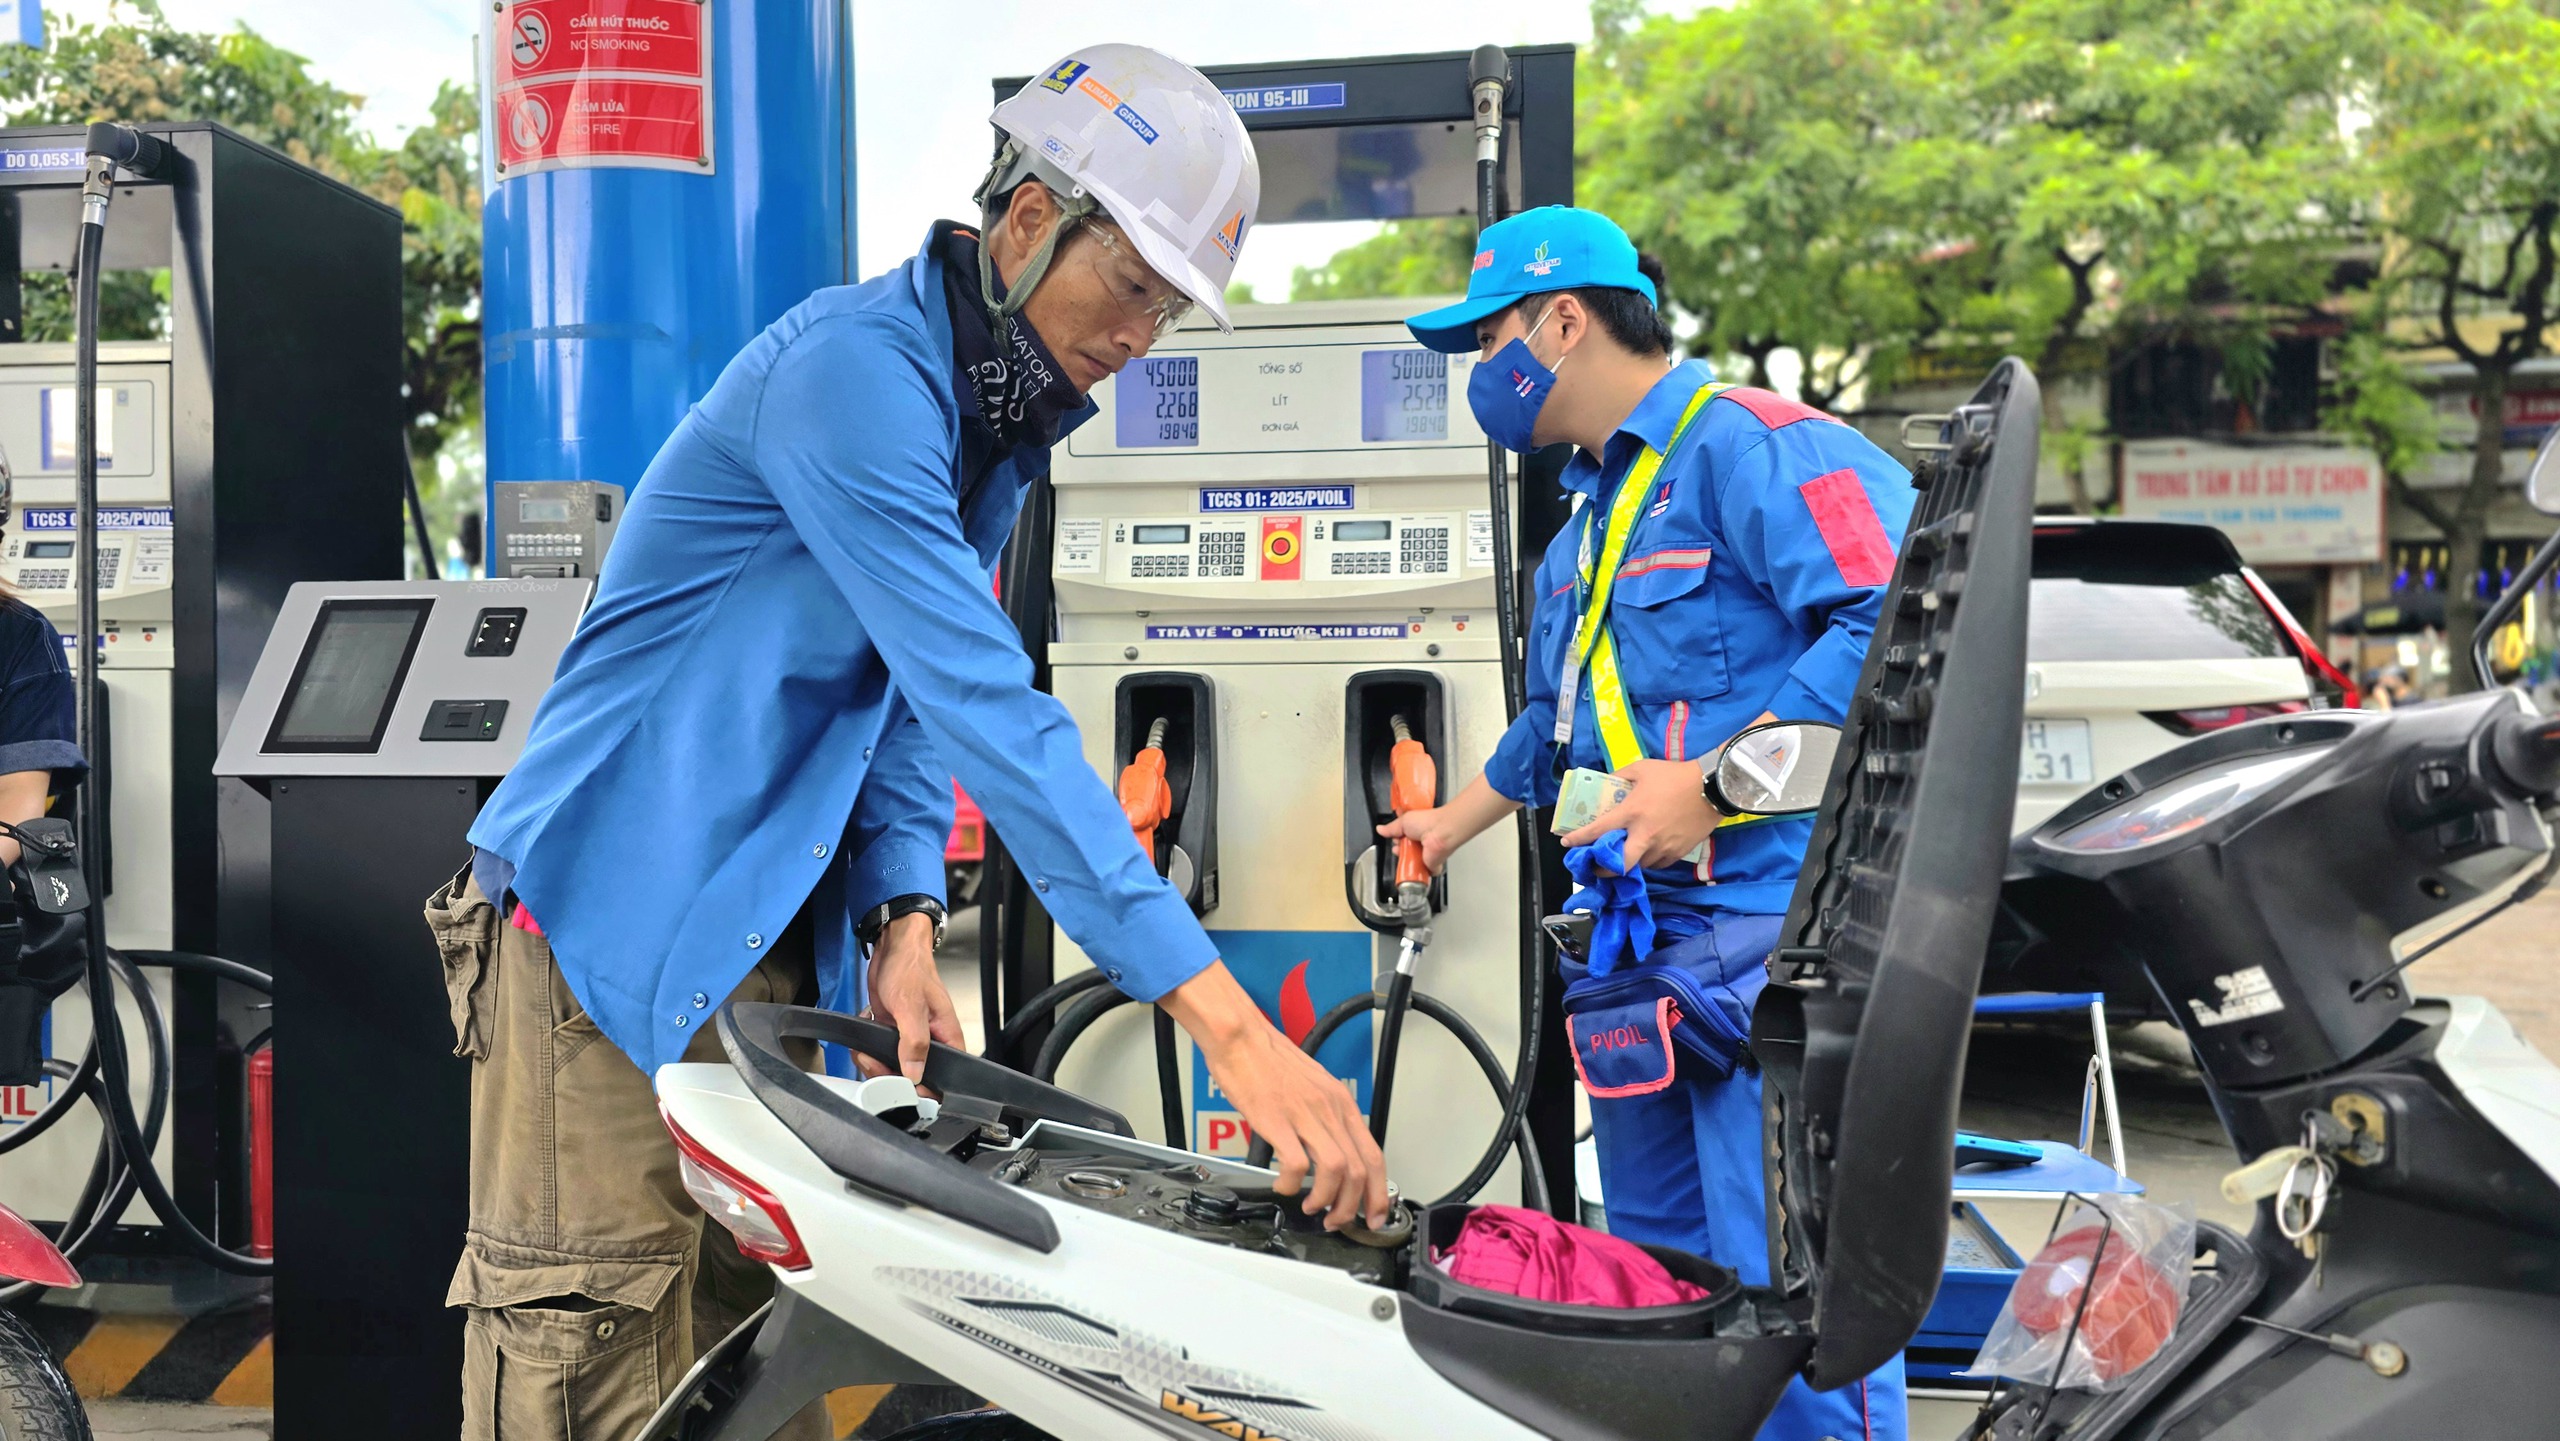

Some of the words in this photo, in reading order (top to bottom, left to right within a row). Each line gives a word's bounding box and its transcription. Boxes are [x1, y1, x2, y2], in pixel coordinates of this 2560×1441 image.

[570, 13, 597, 28] CẤM
[601, 13, 623, 28] HÚT
[626, 15, 669, 31] THUỐC
[570, 40, 588, 50] NO
[591, 39, 650, 51] SMOKING
[1264, 89, 1308, 107] 95-III
[572, 124, 589, 134] NO
[592, 124, 621, 135] FIRE
[1118, 107, 1155, 140] GROUP
[7, 153, 25, 168] DO
[1146, 360, 1198, 387] 45000
[1289, 362, 1303, 374] SỐ
[1392, 352, 1447, 380] 50000
[1156, 391, 1198, 420] 2,268
[1272, 393, 1288, 406] LÍT
[1159, 423, 1197, 439] 19840
[1283, 421, 1299, 432] GIÁ
[1406, 415, 1446, 433] 19840
[1207, 492, 1242, 508] TCCS
[1245, 492, 1267, 507] 01:
[1270, 490, 1346, 506] 2025/PVOIL
[31, 512, 66, 526] TCCS
[97, 512, 173, 526] 2025/PVOIL
[521, 581, 559, 593] Cloud
[1157, 625, 1191, 638] TRẢ
[1321, 627, 1352, 638] KHI
[1357, 626, 1399, 637] BƠM
[1590, 1024, 1648, 1055] PVOIL
